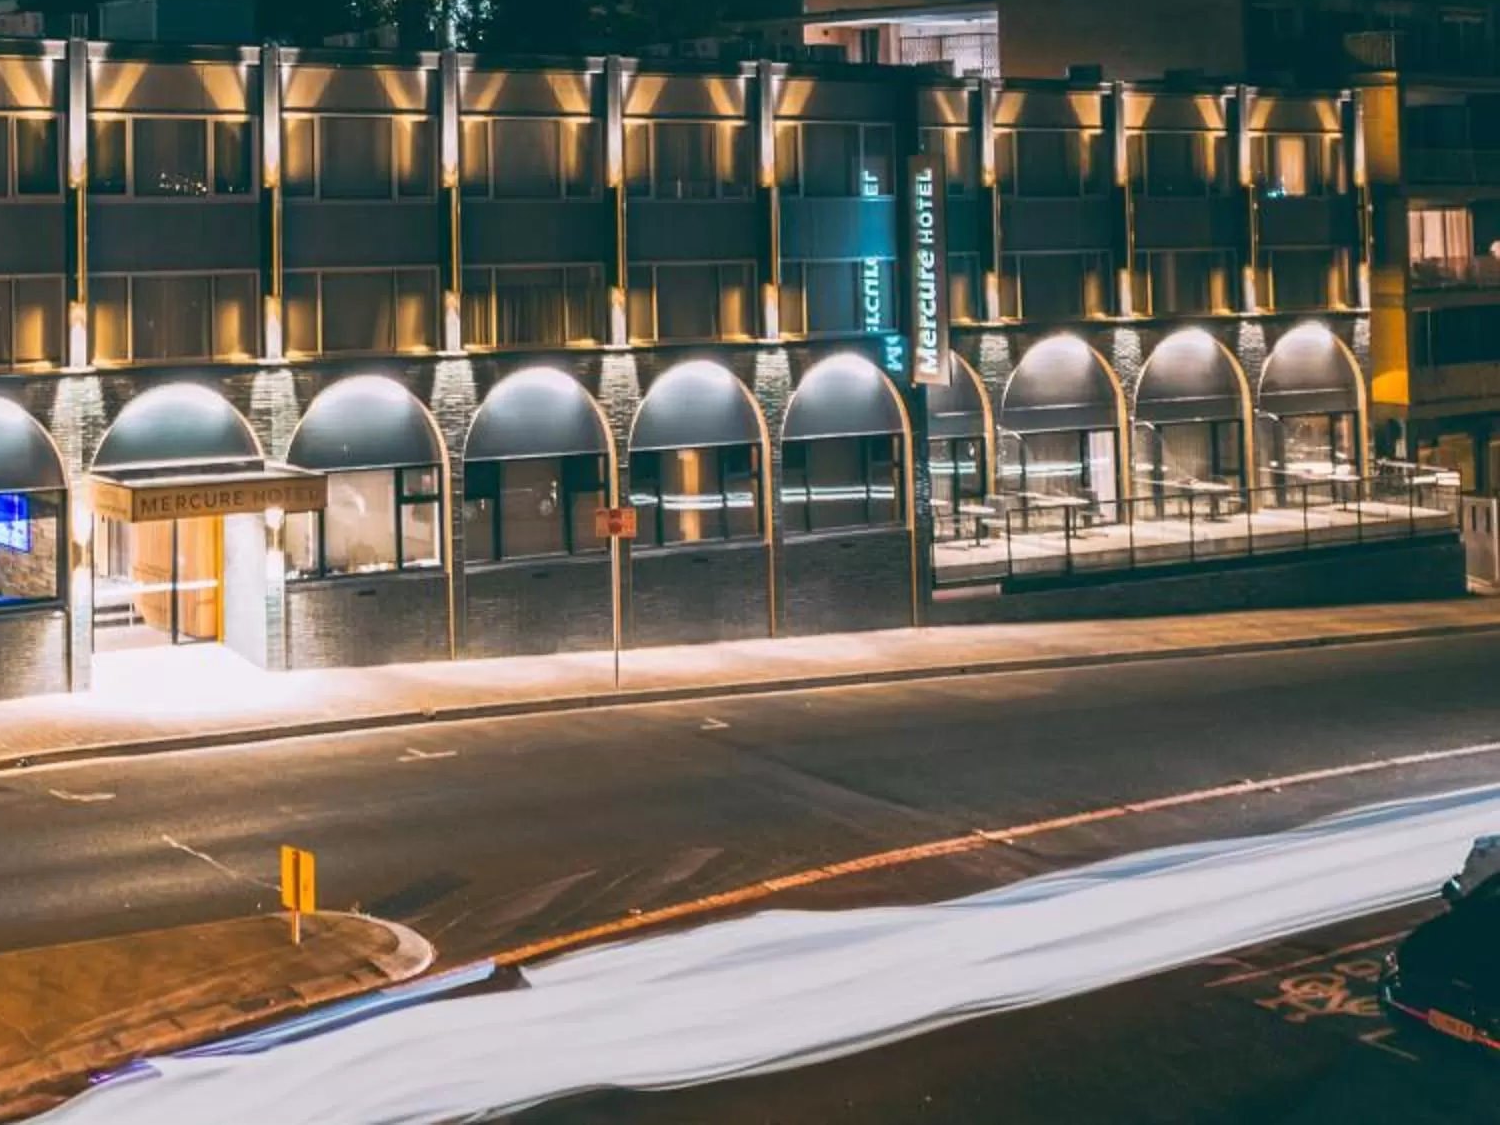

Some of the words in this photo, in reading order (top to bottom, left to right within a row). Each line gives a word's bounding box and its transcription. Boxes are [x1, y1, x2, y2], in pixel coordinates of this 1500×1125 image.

[916, 168, 934, 243] HOTEL
[916, 251, 938, 373] Mercure
[140, 490, 245, 515] MERCURE
[252, 485, 318, 506] HOTEL
